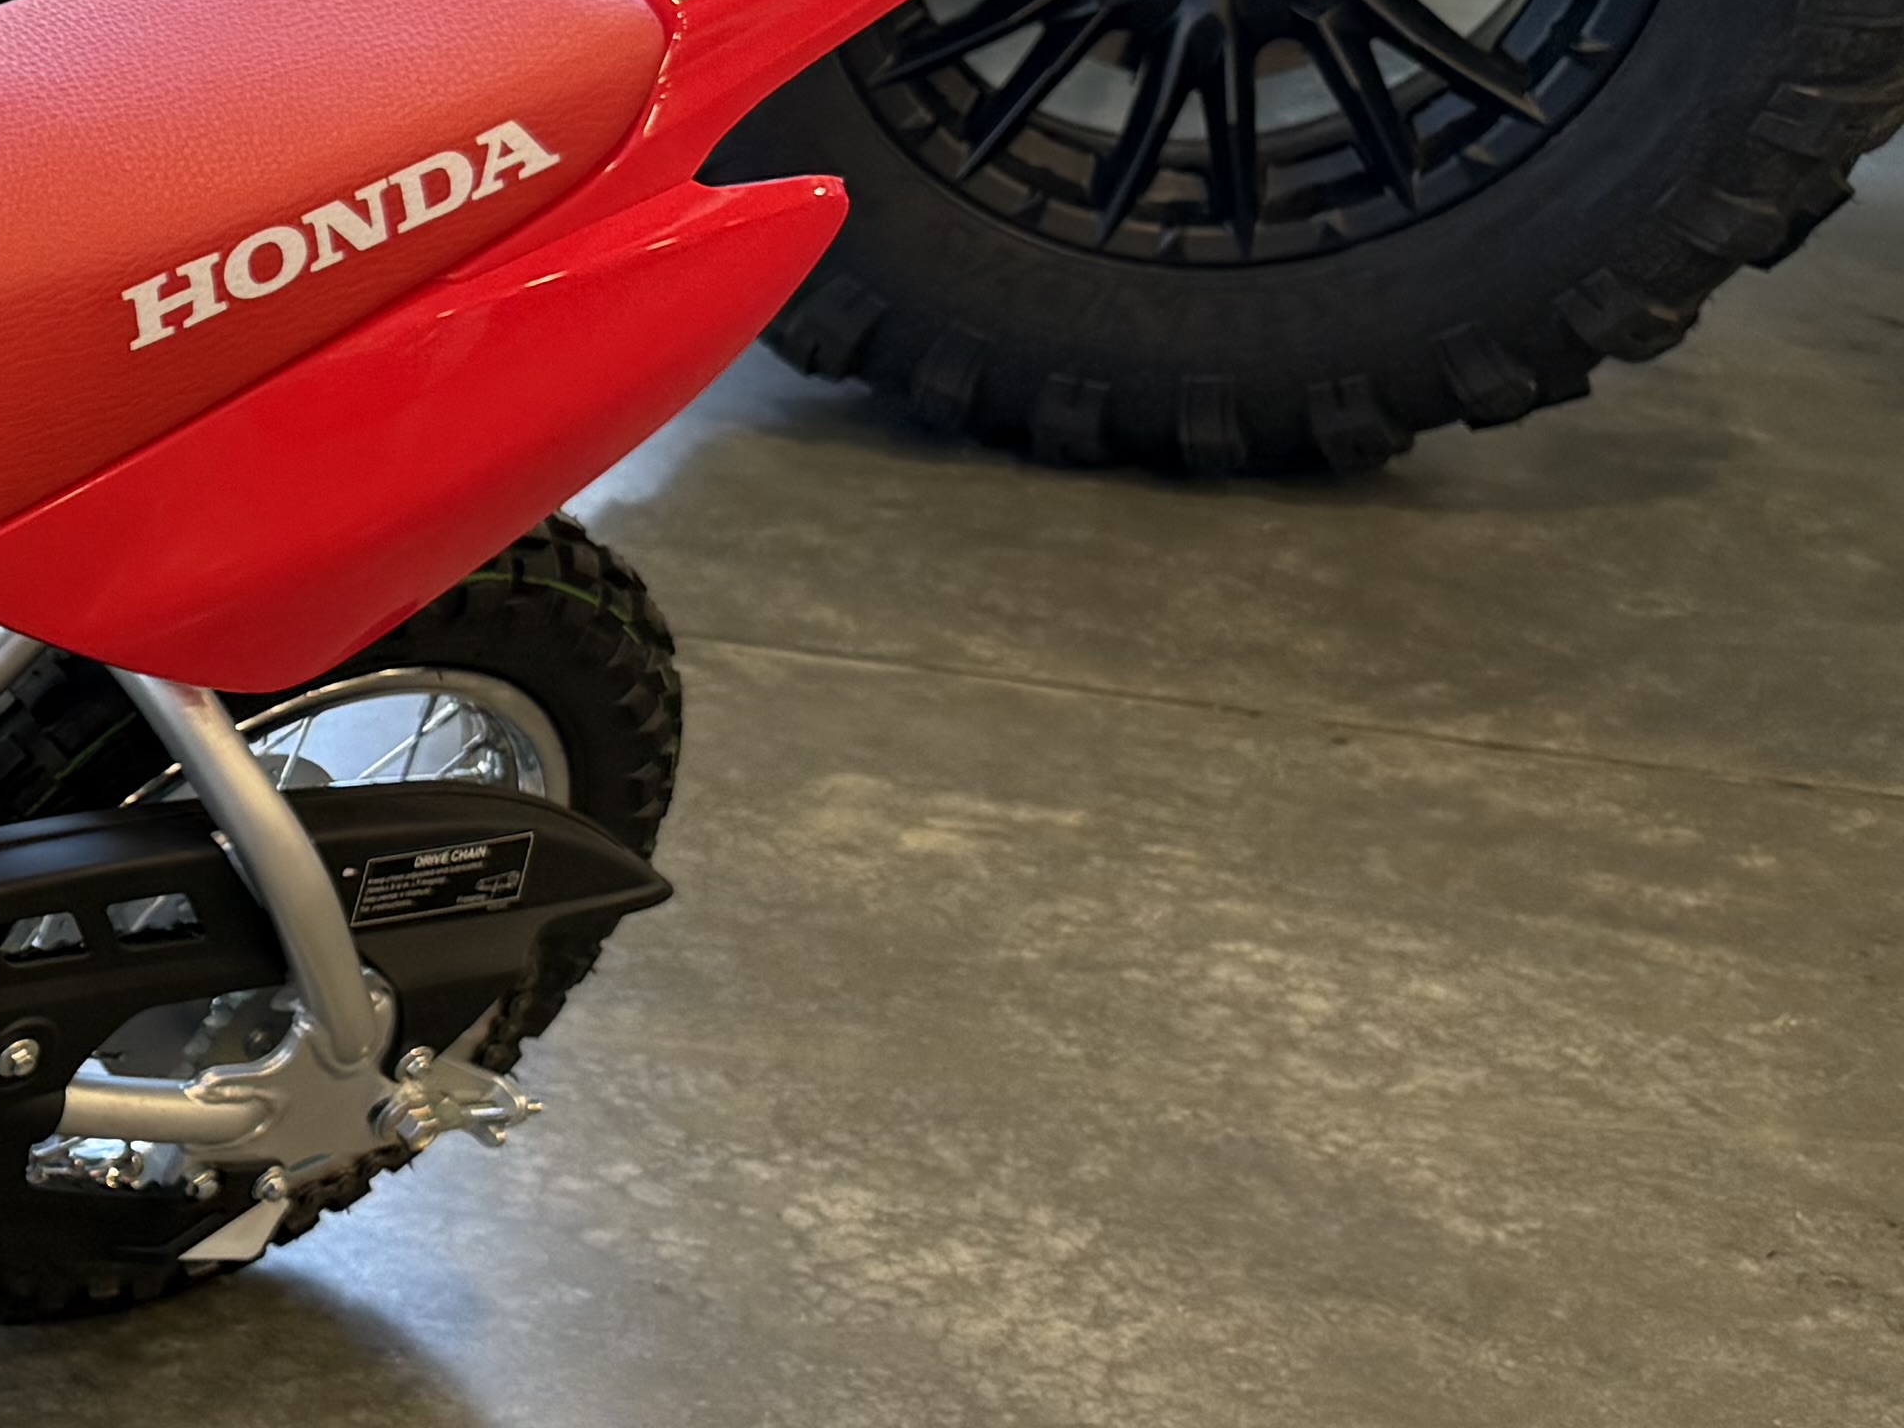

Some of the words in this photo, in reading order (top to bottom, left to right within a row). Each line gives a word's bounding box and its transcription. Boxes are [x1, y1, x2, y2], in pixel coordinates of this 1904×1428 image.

[122, 119, 560, 351] HONDA
[414, 851, 451, 869] DRIVE
[451, 845, 489, 863] CHAIN
